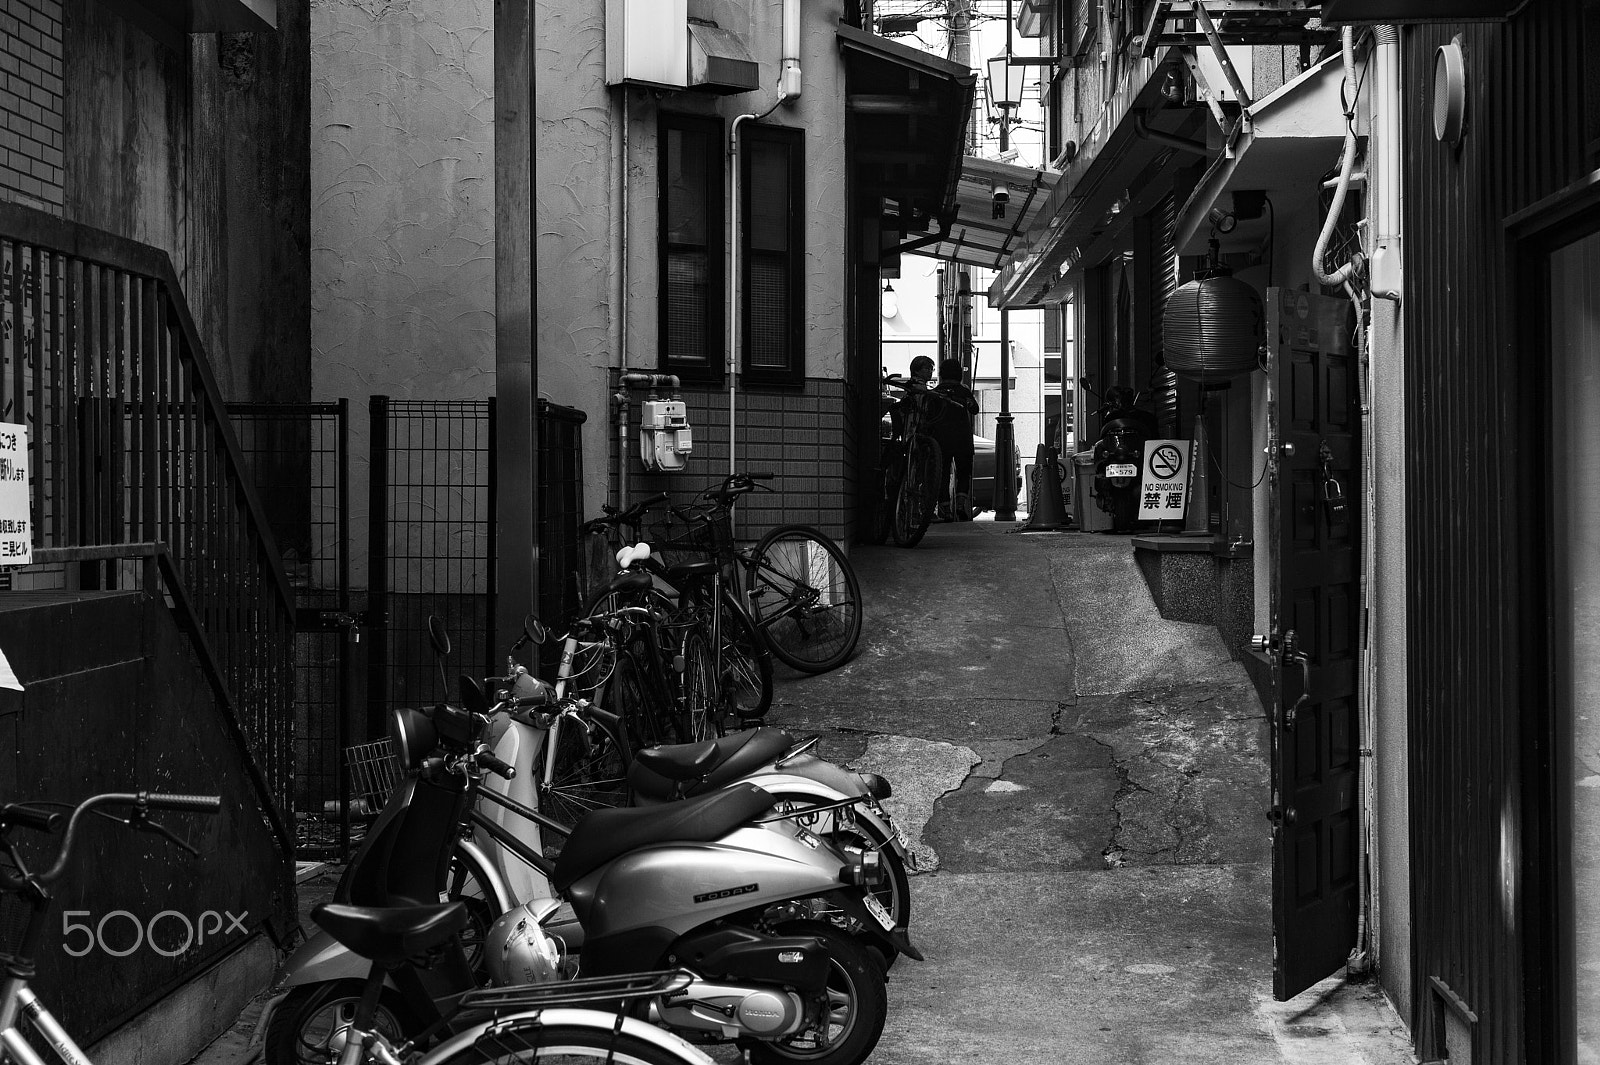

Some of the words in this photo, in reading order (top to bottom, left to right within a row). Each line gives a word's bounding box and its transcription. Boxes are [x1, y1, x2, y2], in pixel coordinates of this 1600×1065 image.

[1144, 483, 1154, 491] NO
[1155, 483, 1184, 491] SMOKING
[1143, 492, 1183, 510] 禁煙
[695, 885, 756, 902] TODAY
[745, 1009, 780, 1018] HONDA
